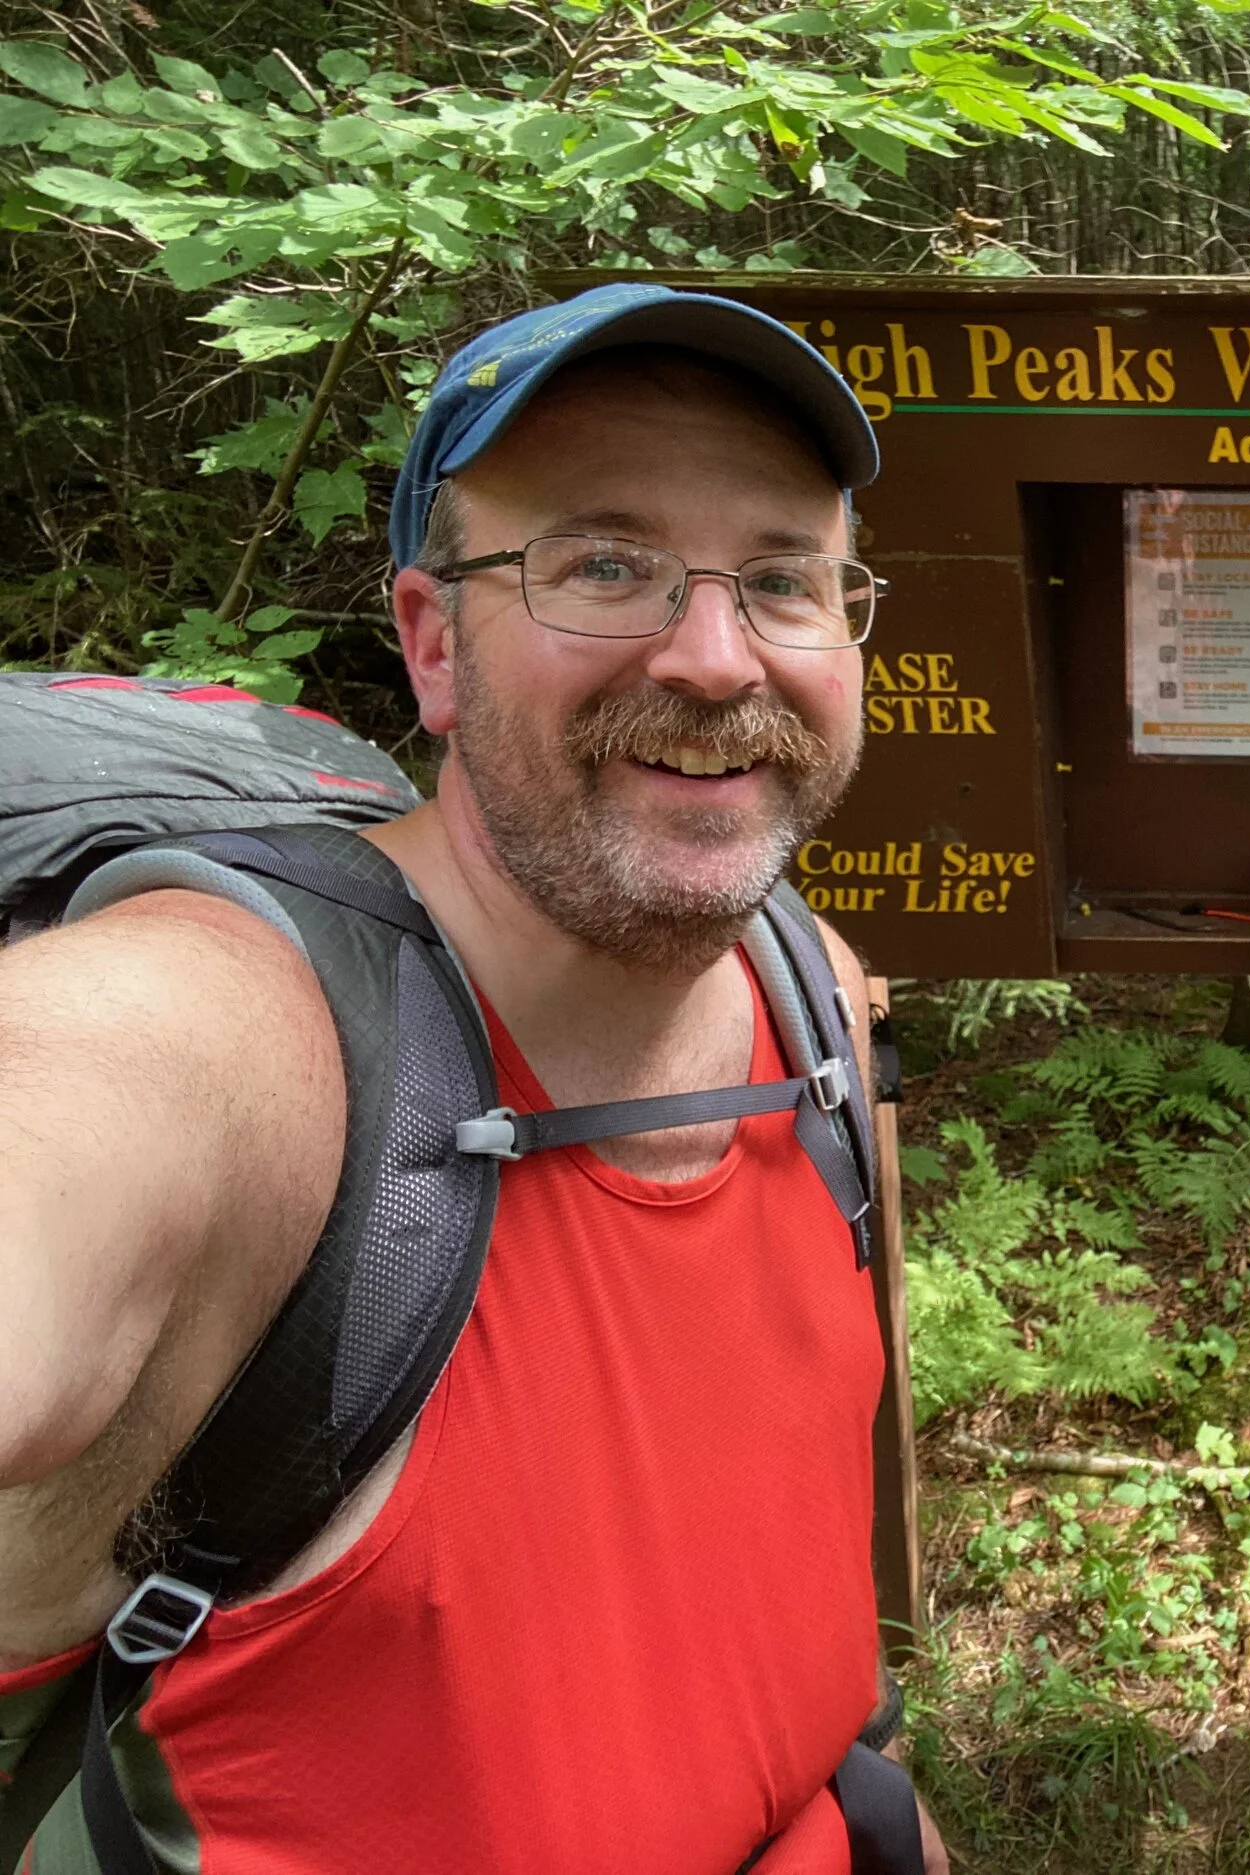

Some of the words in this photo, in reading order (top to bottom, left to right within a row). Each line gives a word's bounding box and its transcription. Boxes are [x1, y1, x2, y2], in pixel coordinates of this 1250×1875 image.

[960, 324, 1176, 403] Peaks
[1183, 510, 1243, 531] SOCIAL
[864, 653, 958, 692] ASE
[867, 696, 998, 734] STER
[797, 840, 921, 876] Could
[940, 843, 1036, 877] Save
[905, 880, 1012, 914] Life!
